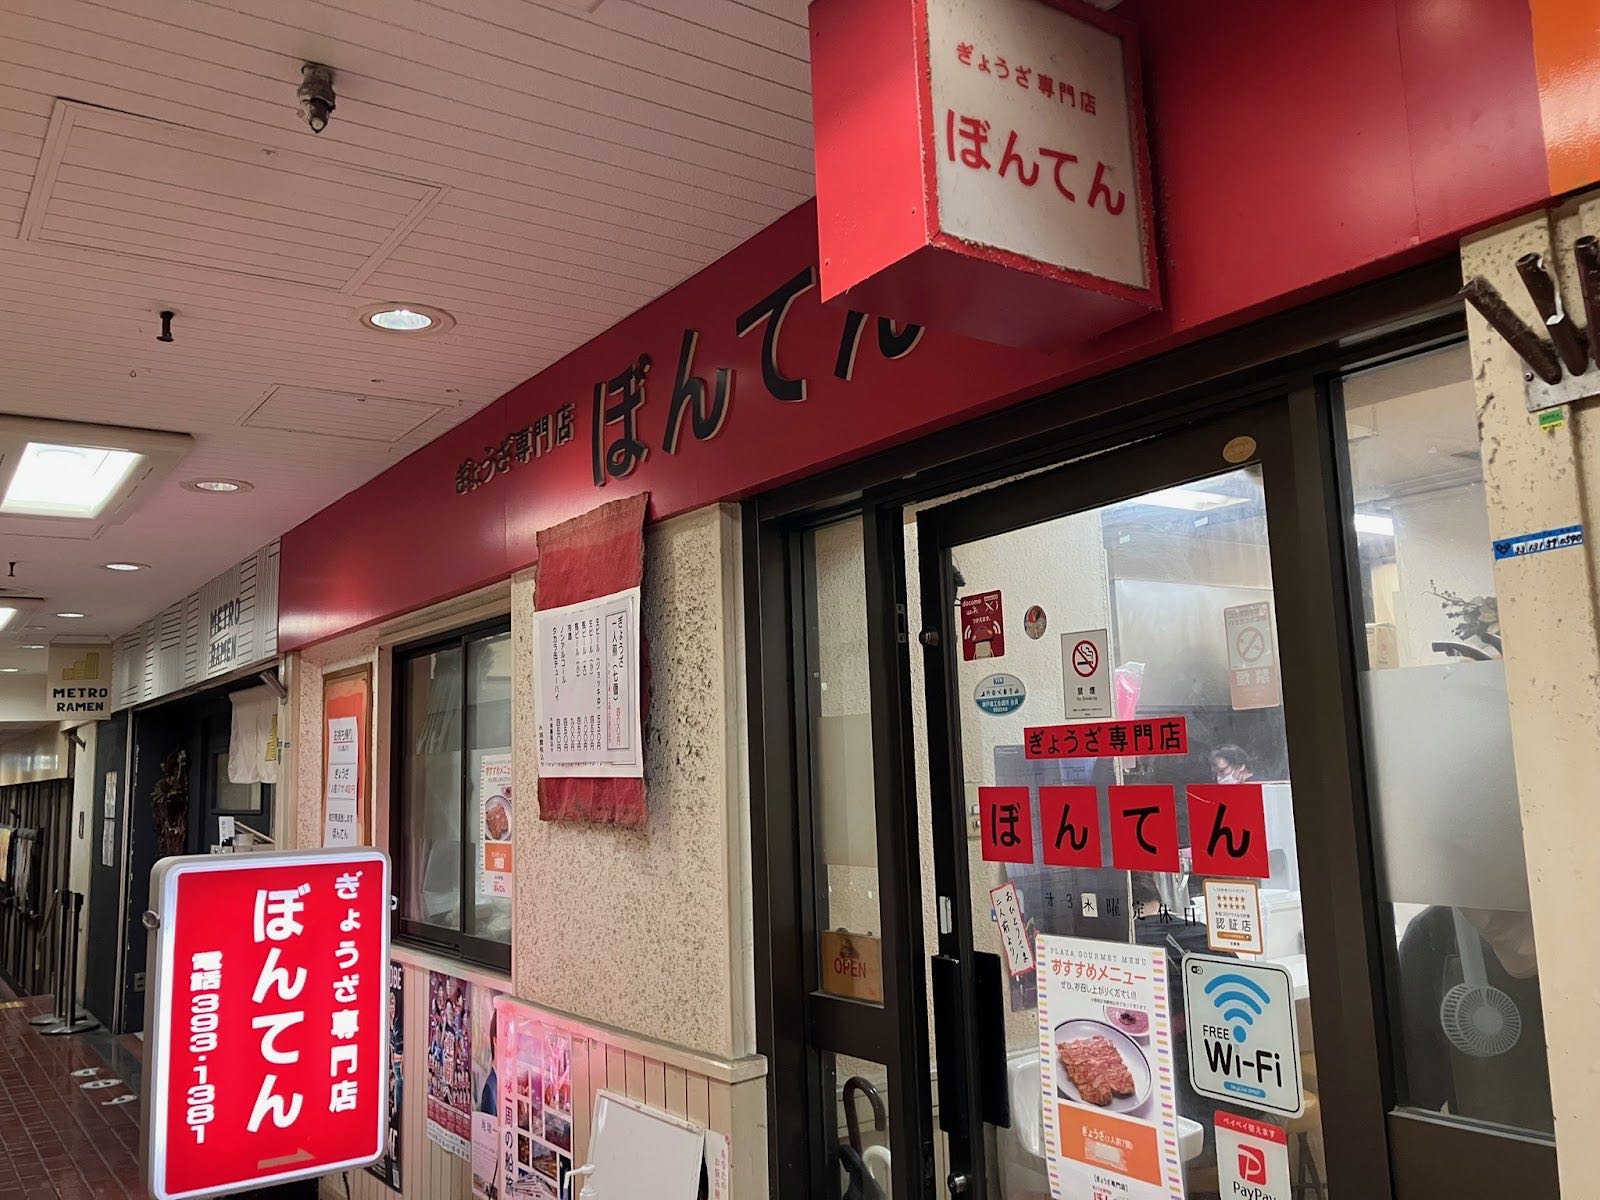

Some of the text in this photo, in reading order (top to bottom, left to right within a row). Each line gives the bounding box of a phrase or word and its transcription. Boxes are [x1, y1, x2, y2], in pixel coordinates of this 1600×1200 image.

[956, 42, 1096, 116] ぎょうざ専門店
[948, 109, 1125, 215] ぼんてん
[455, 402, 576, 495] ぎょうざ専門店
[210, 598, 241, 637] METRO
[962, 599, 982, 607] docomo
[53, 687, 108, 698] METRO
[56, 701, 104, 712] RAMEN
[1028, 722, 1181, 755] ぎょうざ専門店
[991, 803, 1250, 858] ぼんてん
[1216, 917, 1251, 932] 認証店
[833, 956, 867, 979] OPEN
[1050, 947, 1147, 966] PLAZA GOURMET MENU
[1051, 958, 1147, 985] おすすめメニュー
[329, 870, 363, 1113] ぎょうざ専門店
[246, 882, 311, 1133] ぼんてん
[1203, 1024, 1230, 1041] FREE
[1203, 1038, 1282, 1087] Wi-Fi
[1223, 1117, 1276, 1139] ペイペイ使えます
